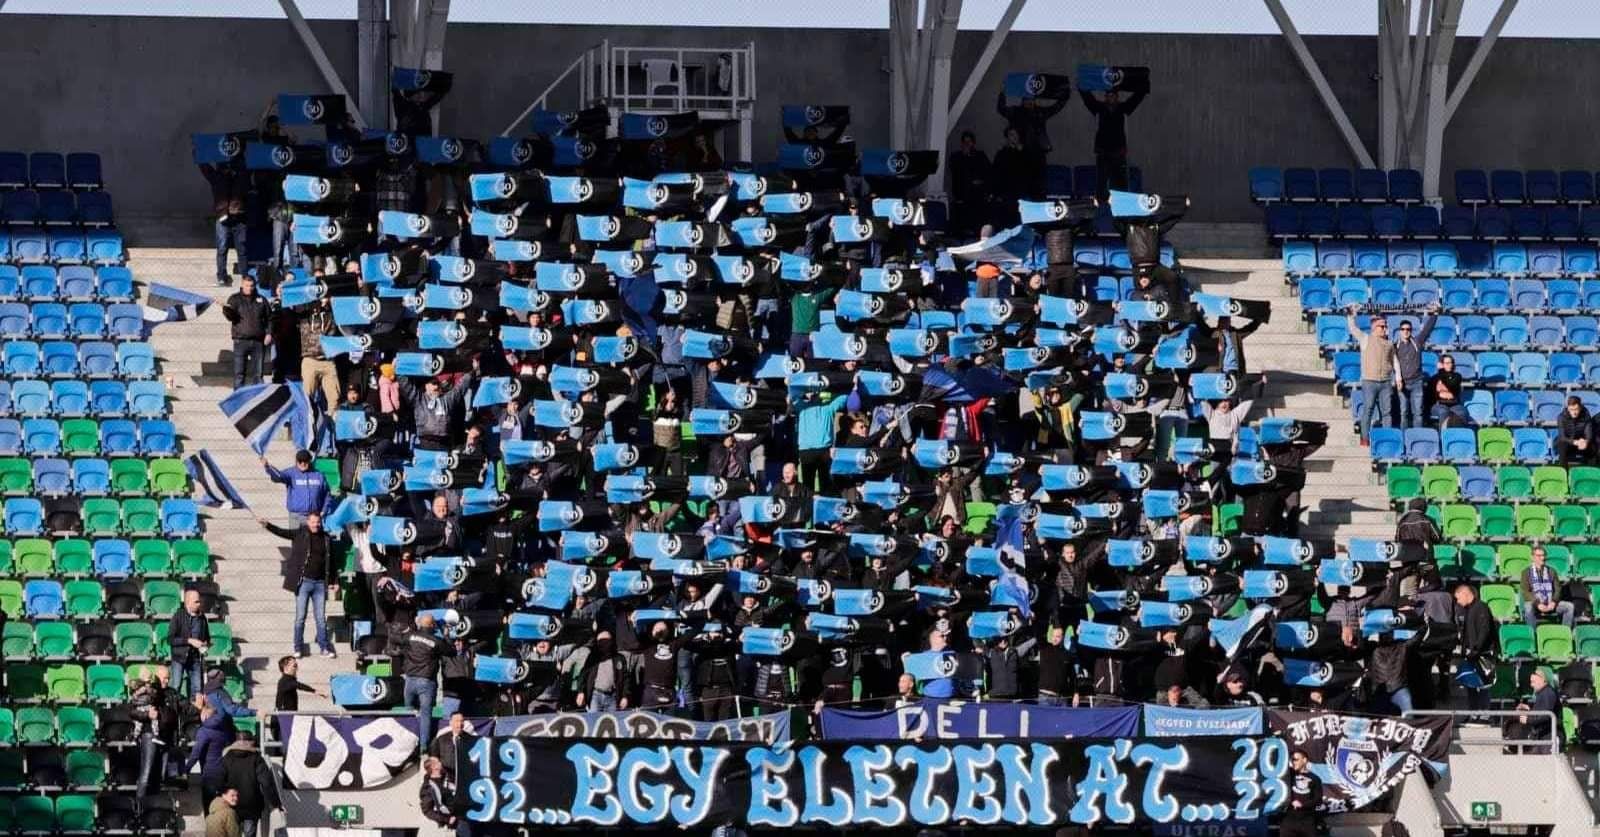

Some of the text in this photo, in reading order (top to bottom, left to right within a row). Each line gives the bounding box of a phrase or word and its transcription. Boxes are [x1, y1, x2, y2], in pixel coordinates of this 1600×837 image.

[467, 738, 527, 782] 19
[1233, 738, 1288, 782] 20
[567, 744, 731, 827] EGY
